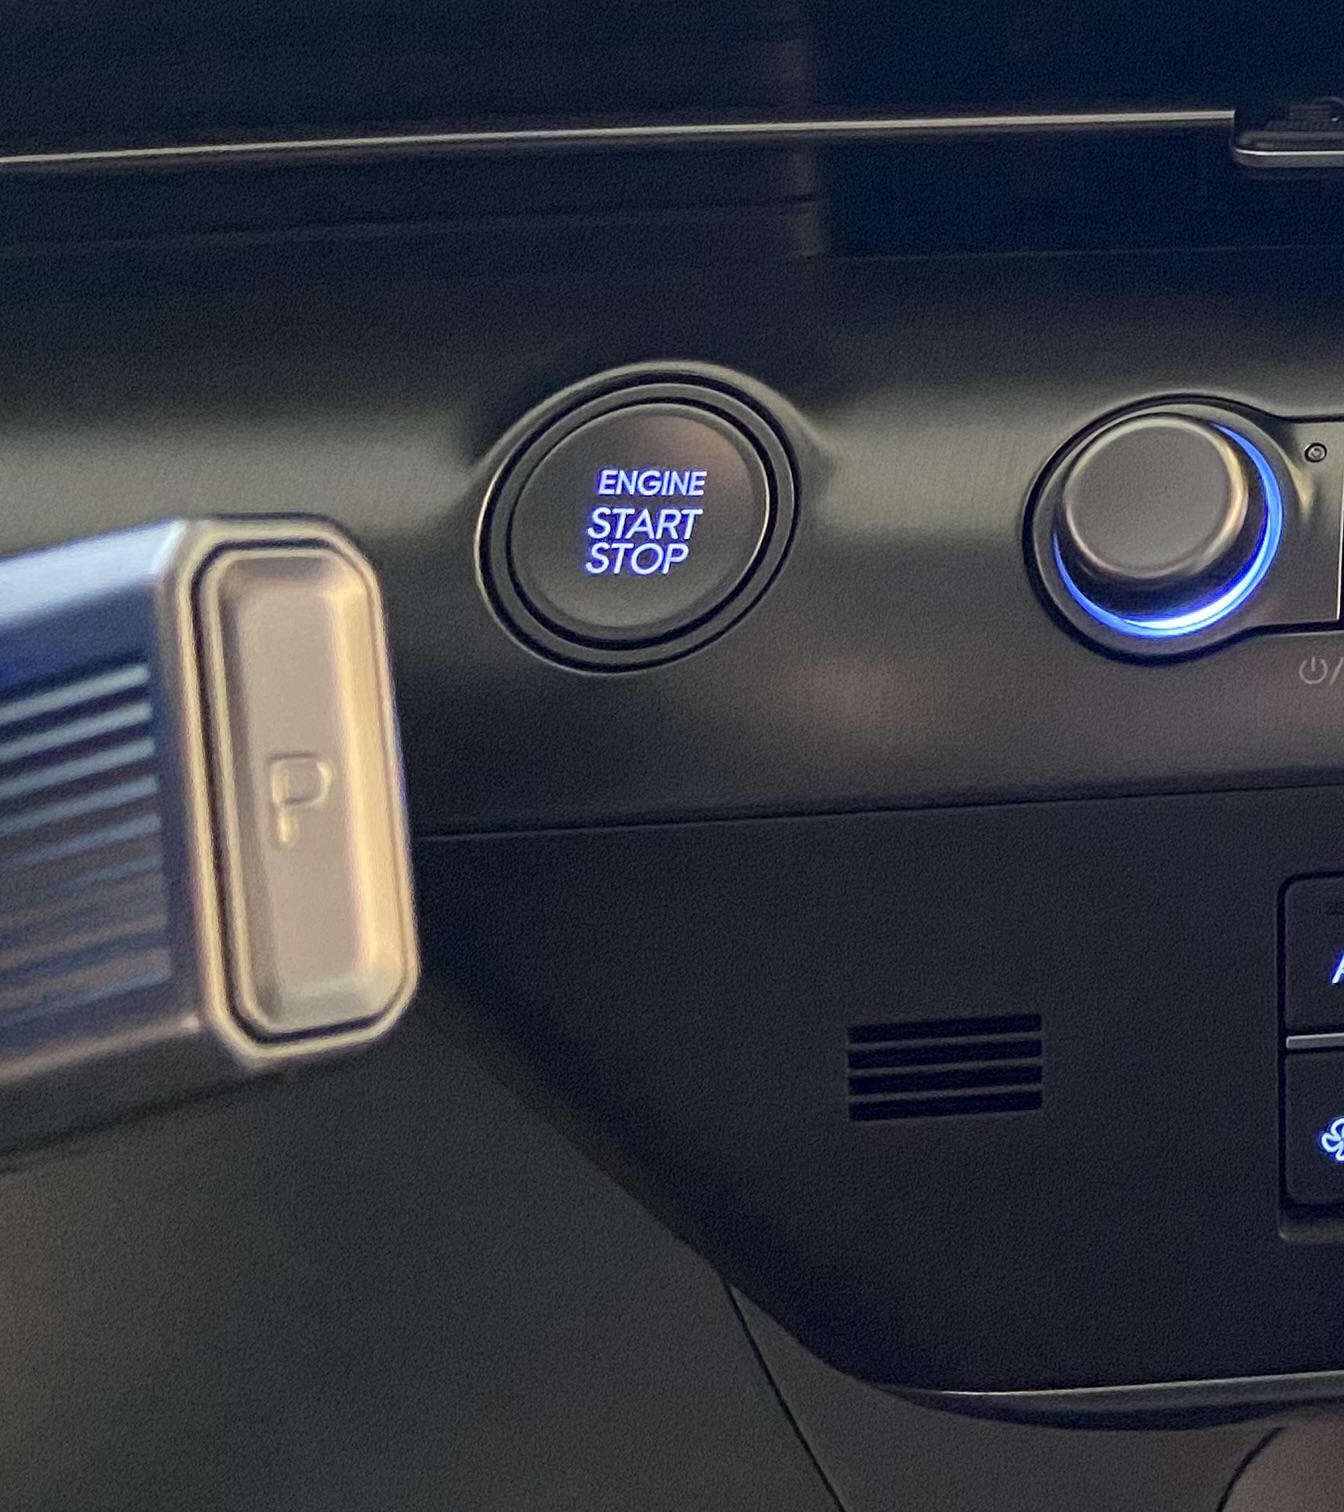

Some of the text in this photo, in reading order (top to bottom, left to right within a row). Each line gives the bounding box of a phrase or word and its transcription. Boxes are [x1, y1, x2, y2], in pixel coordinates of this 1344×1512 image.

[598, 469, 707, 496] ENGINE
[587, 506, 704, 540] START
[585, 541, 690, 576] STOP
